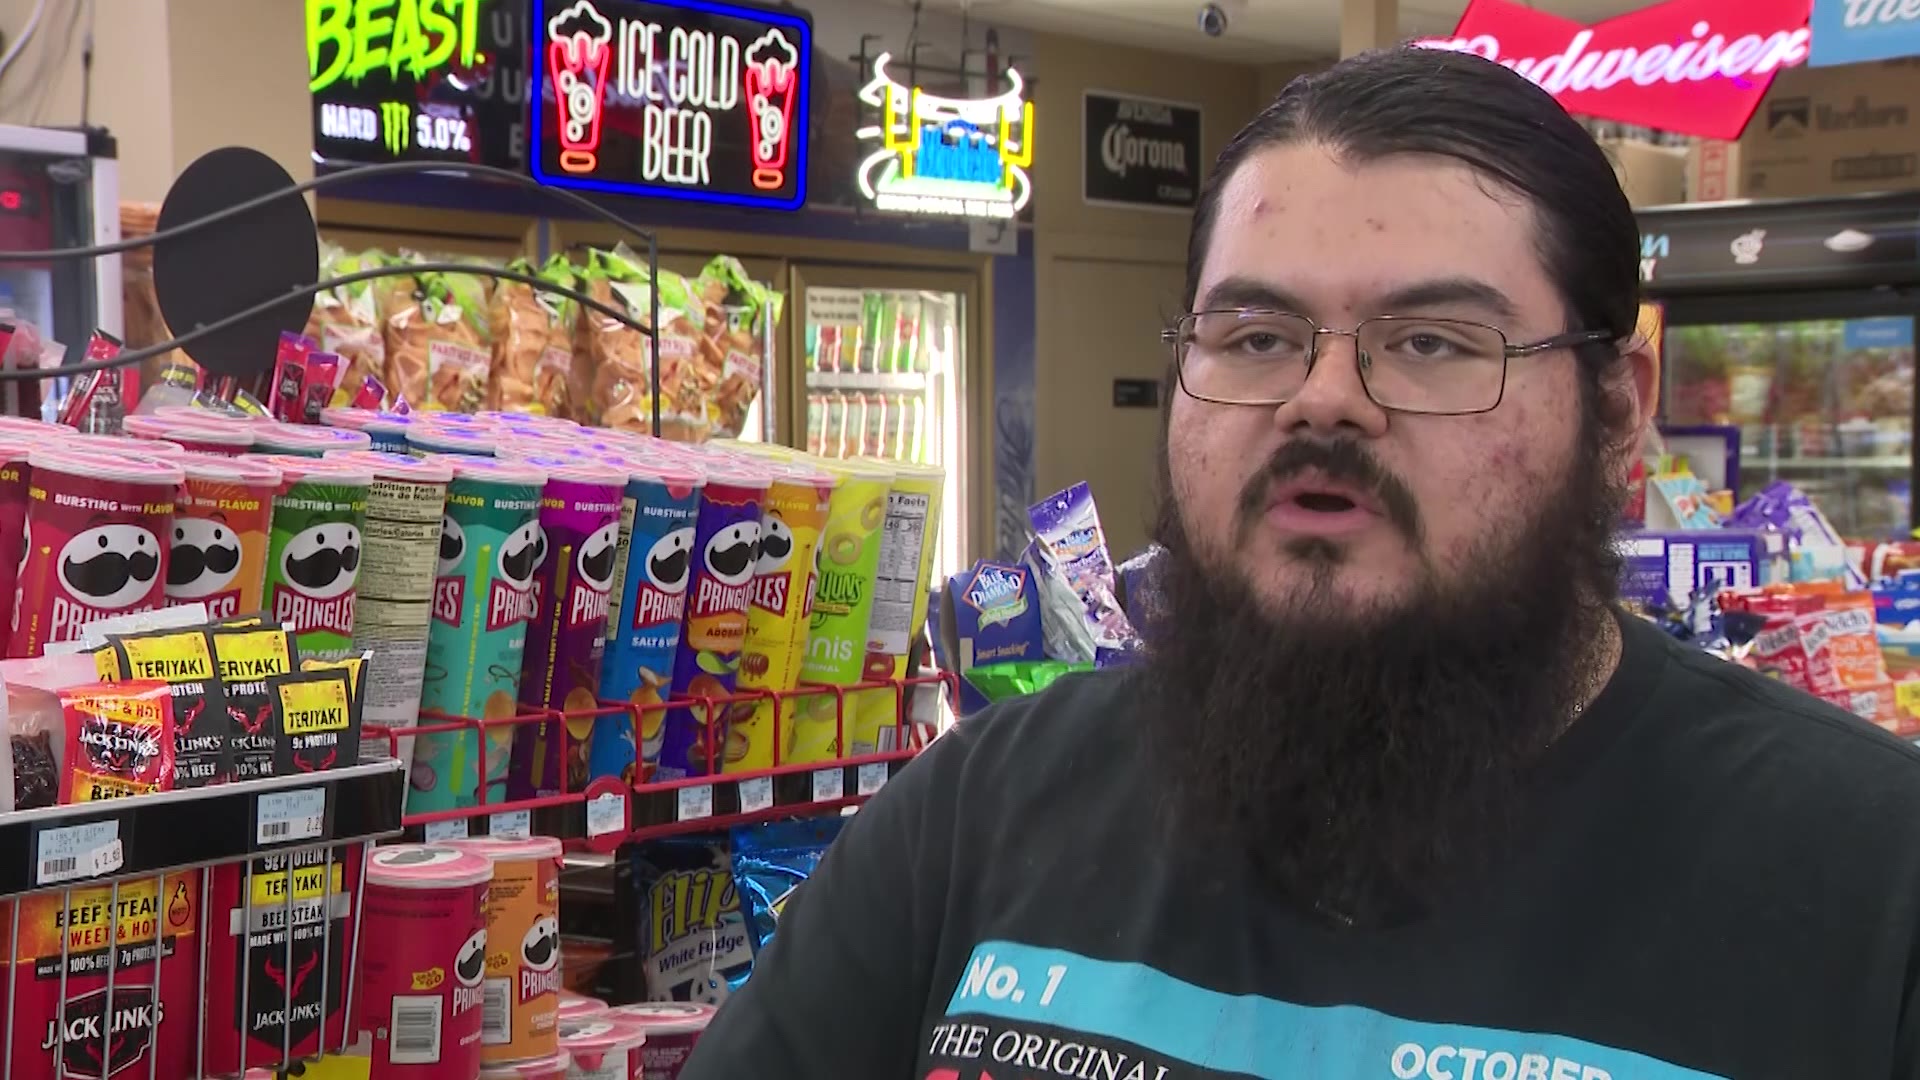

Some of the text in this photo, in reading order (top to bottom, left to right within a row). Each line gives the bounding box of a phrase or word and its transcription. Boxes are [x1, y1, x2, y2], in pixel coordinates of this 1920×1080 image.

[617, 18, 663, 100] ICE
[669, 26, 740, 110] COLD
[321, 103, 472, 151] HARD 5.0%
[643, 104, 711, 185] BEER
[1102, 123, 1187, 178] Corona
[54, 493, 118, 511] BURSTING
[219, 500, 260, 511] FLAVOR
[644, 506, 686, 518] BURSTING
[971, 574, 1021, 607] DIAMOND
[978, 571, 1005, 591] BLUE
[632, 636, 657, 648] SALT
[136, 658, 205, 678] TERIYAKI
[220, 658, 282, 677] ERIYAKI
[231, 681, 268, 695] PROTE
[136, 703, 160, 719] HOT
[288, 708, 342, 728] TERIYAKI
[305, 733, 338, 749] PROTEIN
[280, 848, 324, 869] POTEIN
[266, 873, 323, 896] TERYAKI
[117, 926, 126, 939] &
[69, 954, 95, 973] 100%
[121, 949, 132, 967] 7g
[659, 947, 696, 973] White
[699, 934, 744, 954] Fudge
[960, 953, 1067, 1007] No. 1
[253, 1010, 285, 1031] JACK
[928, 1023, 989, 1059] THE
